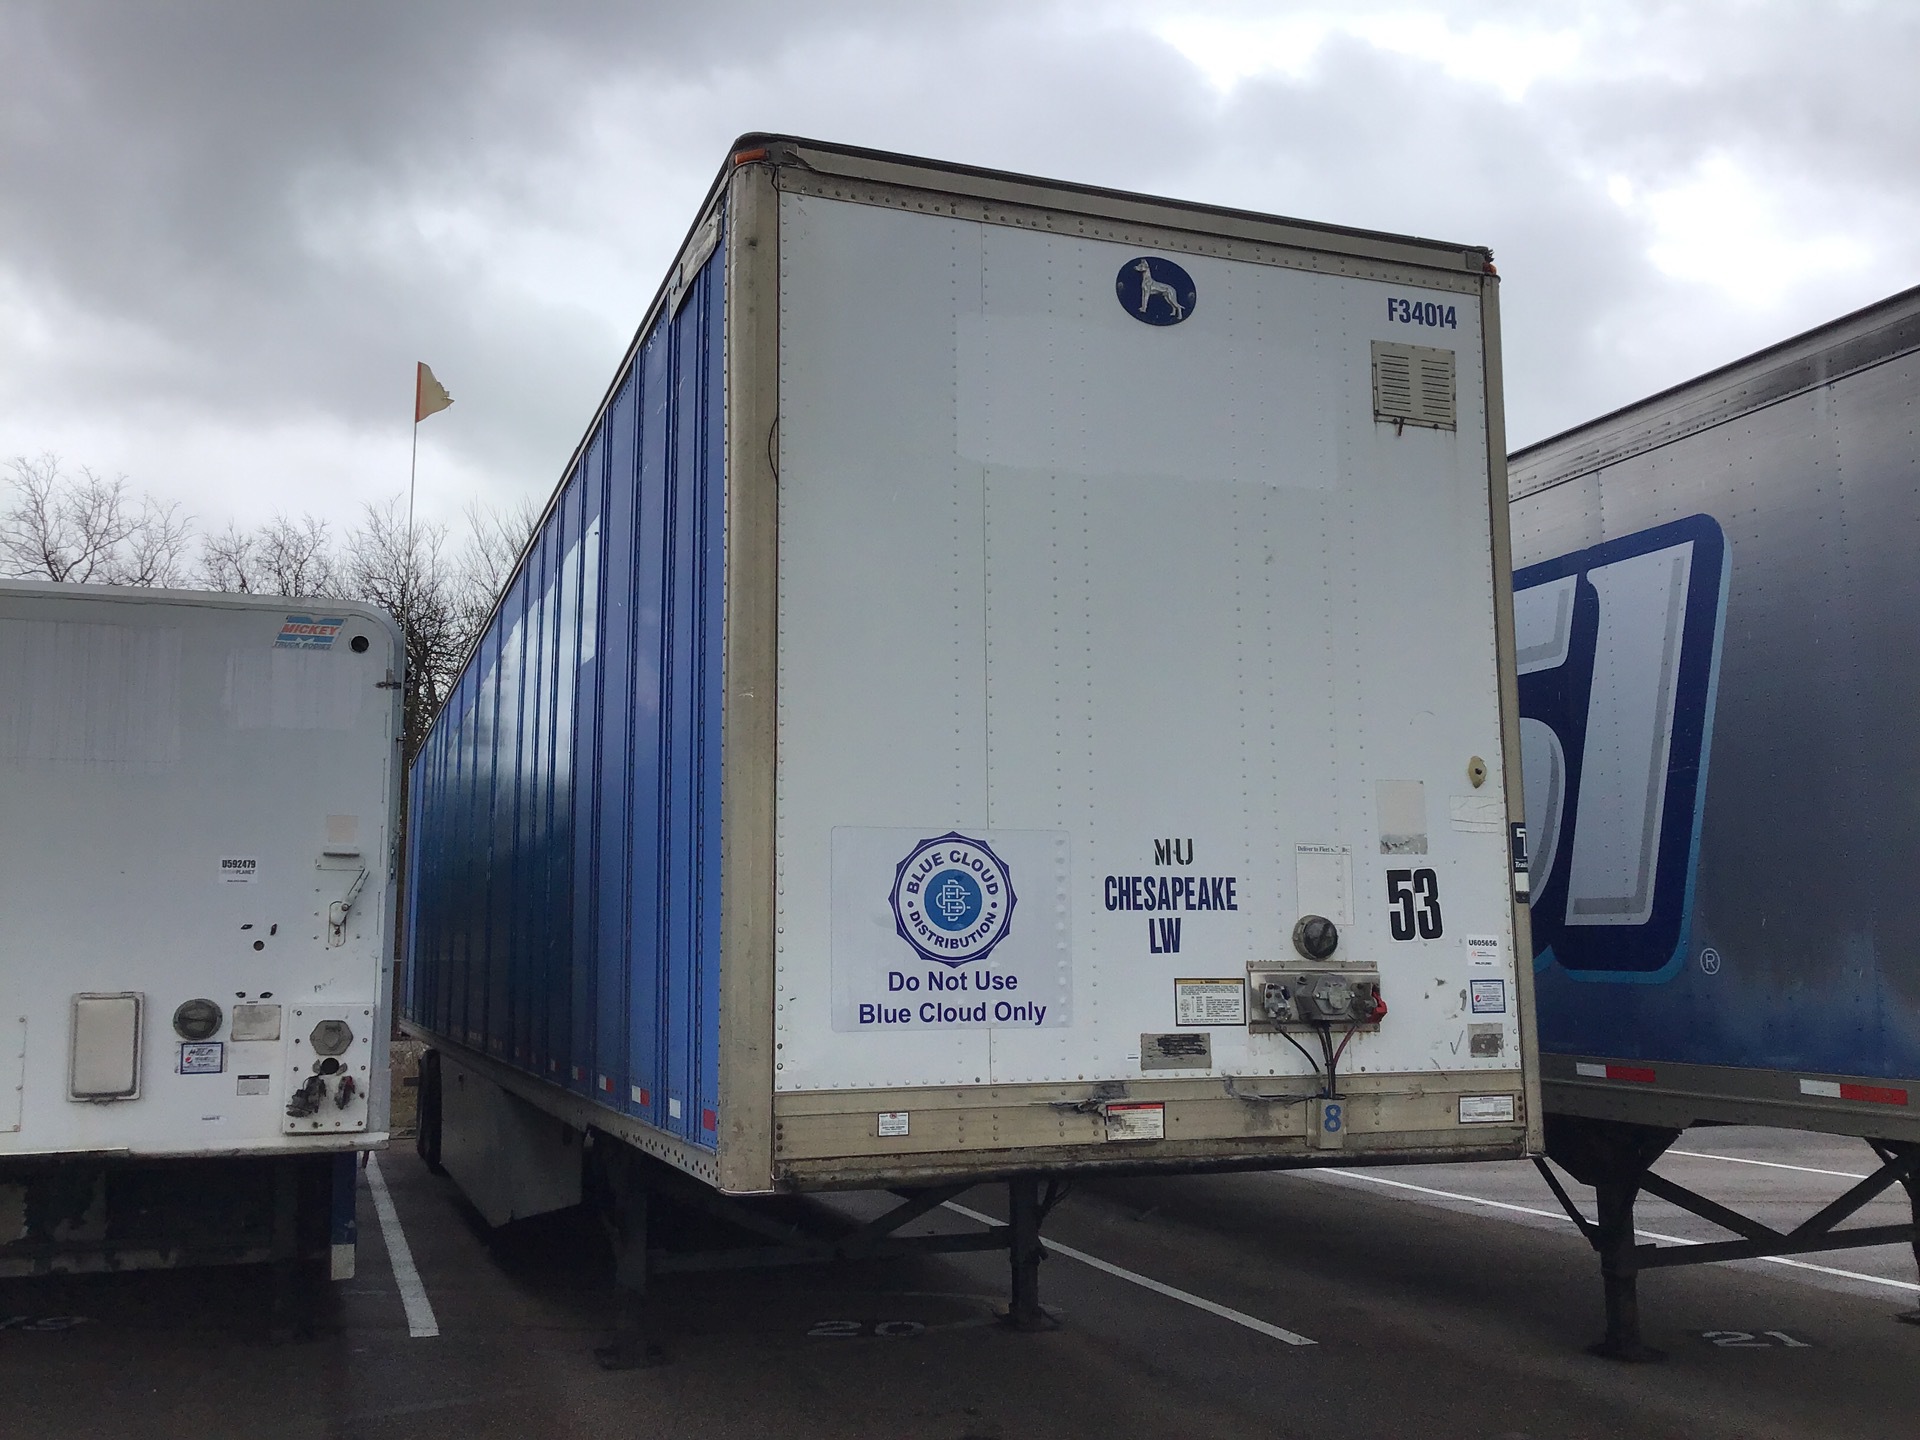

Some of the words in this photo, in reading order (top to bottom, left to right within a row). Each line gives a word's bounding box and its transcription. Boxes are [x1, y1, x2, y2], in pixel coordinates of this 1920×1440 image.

[1387, 298, 1457, 329] F34014
[281, 624, 340, 636] MICKEY
[1153, 837, 1193, 866] MU
[906, 852, 944, 895] BLUE
[949, 850, 999, 895] CLOUD
[1104, 875, 1239, 912] CHESAPEAKE
[1385, 867, 1444, 941] 53
[909, 910, 997, 949] DISTRIBUTION
[1148, 917, 1182, 954] LW
[1468, 939, 1498, 947] U605656
[888, 971, 920, 992] Do
[928, 971, 968, 991] Not
[975, 970, 1018, 990] Use
[859, 1003, 912, 1024] Blue
[919, 1002, 987, 1023] Cloud
[994, 1001, 1047, 1026] Only
[1324, 1104, 1342, 1132] 8
[807, 1321, 926, 1337] 20
[1701, 1330, 1813, 1348] 21
